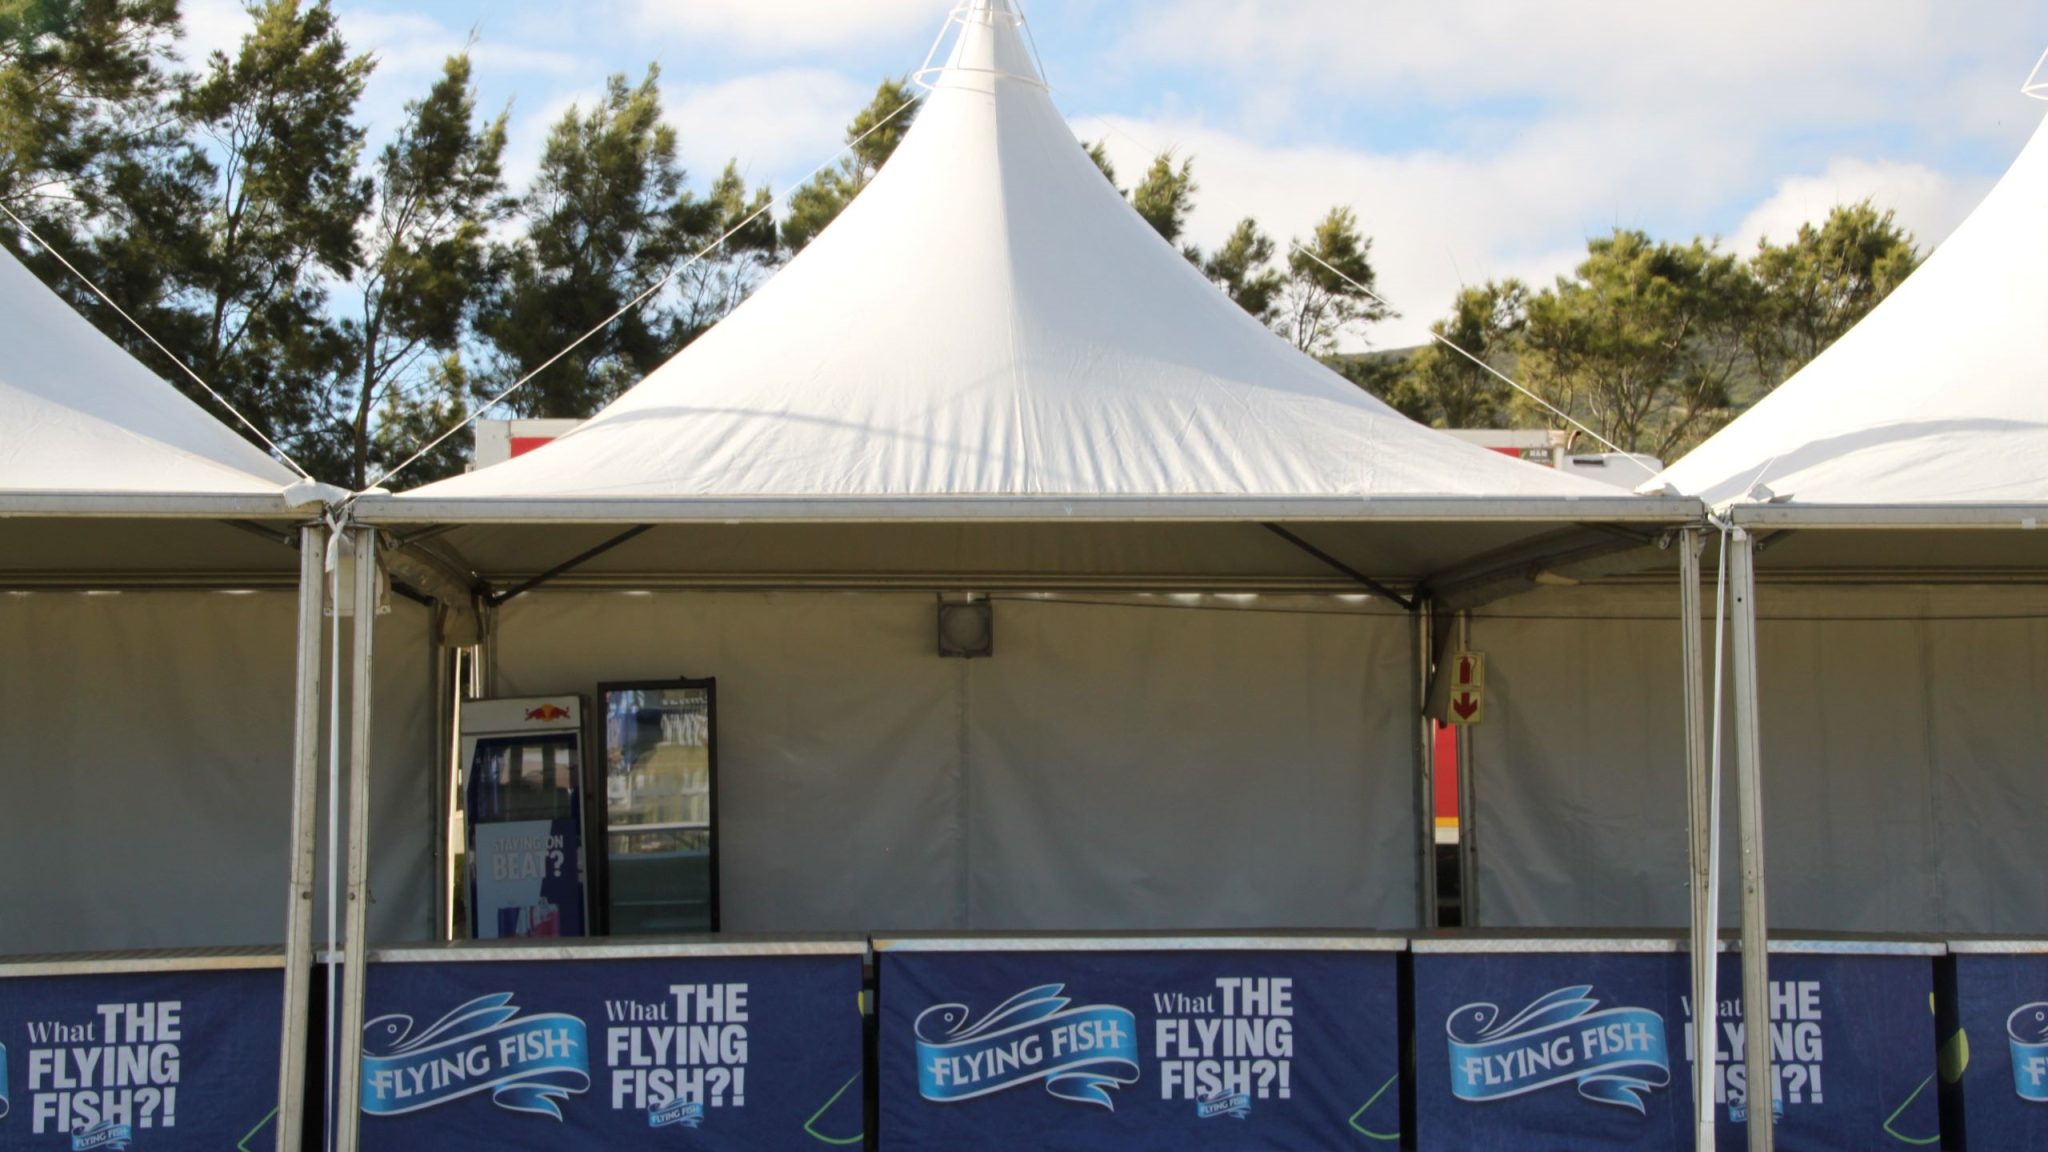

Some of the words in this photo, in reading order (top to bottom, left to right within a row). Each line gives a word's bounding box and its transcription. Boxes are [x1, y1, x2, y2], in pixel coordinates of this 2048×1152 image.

[545, 834, 564, 849] ON
[493, 850, 565, 880] BEAT?
[605, 1000, 668, 1022] What
[669, 983, 748, 1023] THE
[1153, 992, 1215, 1014] What
[1216, 977, 1294, 1016] THE
[1681, 996, 1743, 1017] at
[1769, 981, 1822, 1020] HE
[27, 1021, 95, 1043] What
[97, 1000, 181, 1043] THE
[1155, 1018, 1293, 1058] FLYING
[28, 1043, 180, 1090] FLYING
[368, 1044, 491, 1099] FLYING
[499, 1028, 579, 1068] FISH
[607, 1024, 748, 1067] FLYING
[928, 1034, 1044, 1087] FLYING
[1051, 1019, 1128, 1058] FISH
[1459, 1035, 1574, 1086] FLYING
[1581, 1021, 1657, 1061] FISH
[612, 1066, 745, 1109] FISH?!
[1161, 1059, 1291, 1100] FISH?!
[32, 1087, 176, 1134] FISH?!
